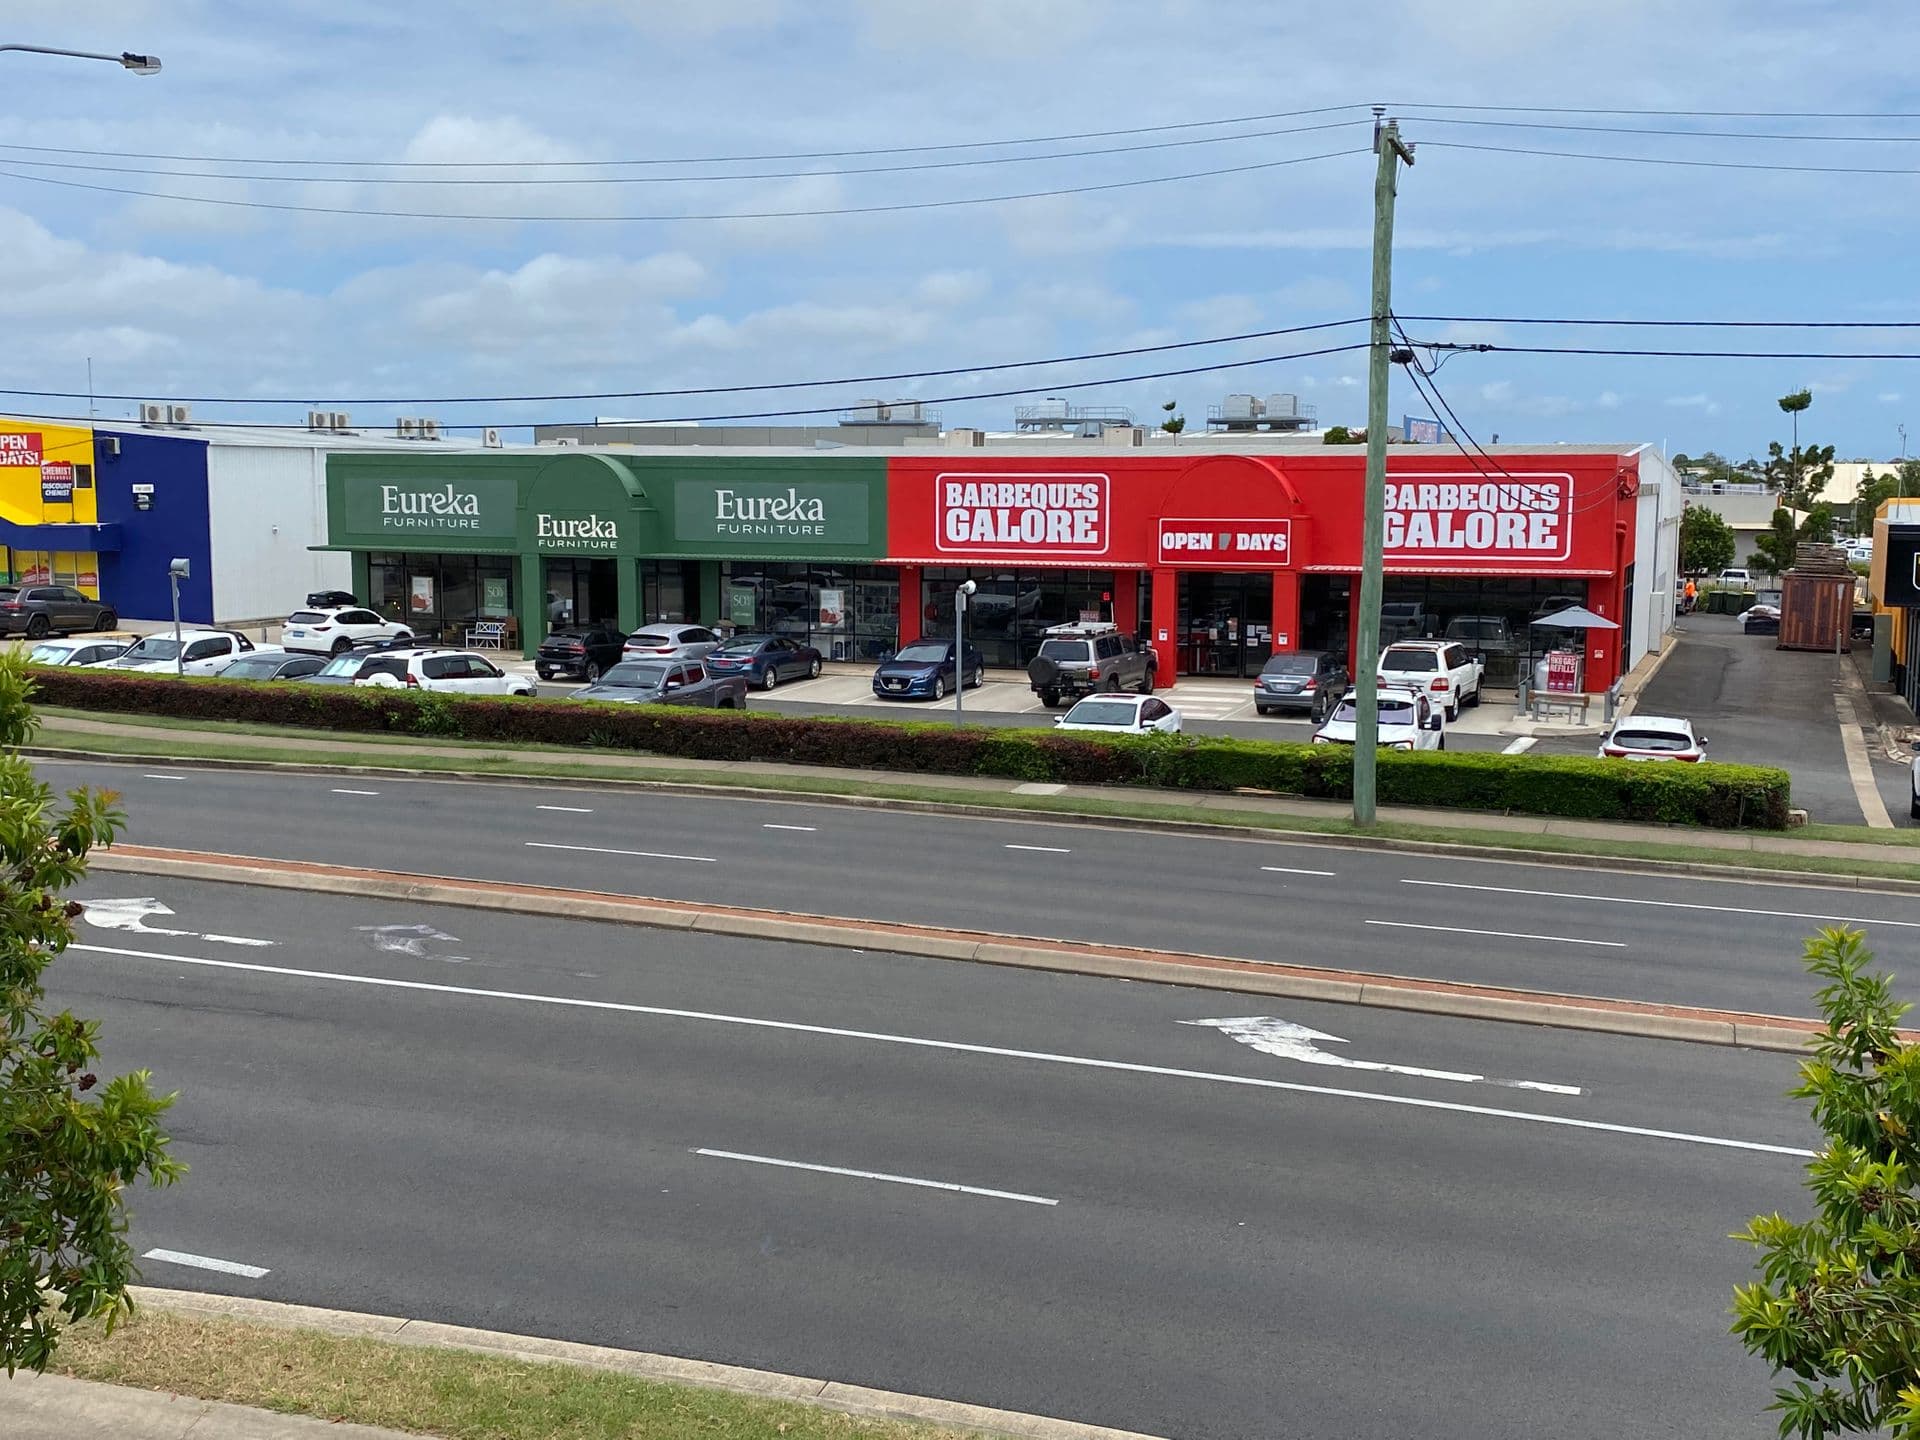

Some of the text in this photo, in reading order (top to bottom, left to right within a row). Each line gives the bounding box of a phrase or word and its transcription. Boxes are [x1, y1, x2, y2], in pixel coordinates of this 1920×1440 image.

[0, 435, 27, 449] PEN
[380, 484, 480, 515] Eureka
[714, 488, 826, 521] Eureka
[946, 483, 1099, 511] BARBEQUES
[1384, 483, 1560, 513] BARBEQUES
[383, 517, 480, 529] FURNITURE
[537, 513, 619, 538] Eureka
[717, 524, 825, 535] FURNITURE
[946, 508, 1099, 543] GALORE
[1383, 511, 1559, 549] GALORE
[538, 539, 617, 549] FURNITURE
[1162, 532, 1213, 550] OPEN
[1236, 533, 1287, 551] DAYS
